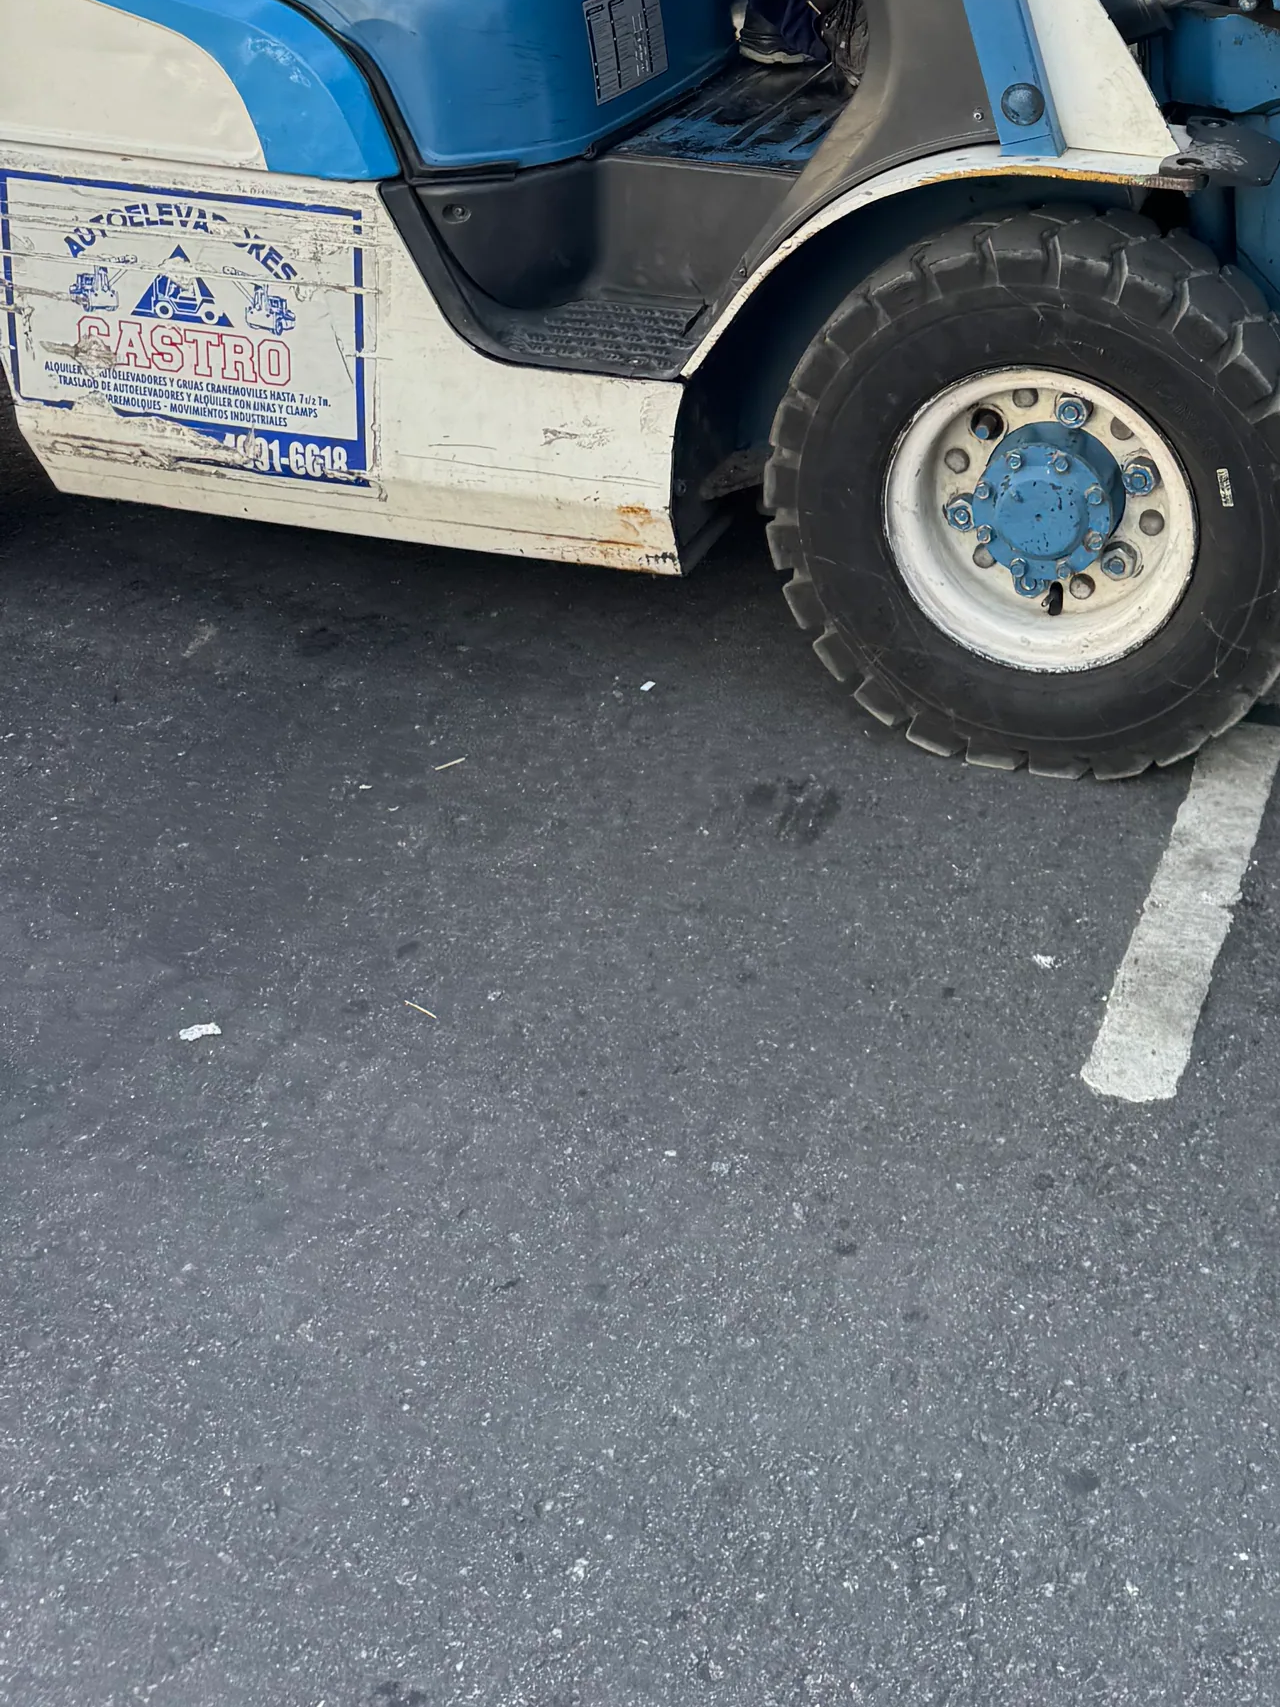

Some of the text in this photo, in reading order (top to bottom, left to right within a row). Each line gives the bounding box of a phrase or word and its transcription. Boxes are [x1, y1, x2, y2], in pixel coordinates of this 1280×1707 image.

[58, 374, 99, 389] TRASLADO
[101, 379, 112, 392] DE
[113, 382, 184, 401] AUTOELEVADORES
[186, 392, 192, 402] Y
[194, 394, 232, 409] ALQUILER
[234, 399, 251, 410] CON
[279, 404, 284, 414] Y
[286, 405, 318, 418] CLAMPS
[169, 377, 175, 388] Y
[176, 379, 204, 391] GRUAS
[206, 382, 267, 400] CRANEMOVILES
[270, 390, 296, 403] HASTA
[170, 405, 229, 420] MOVIMIENTOS
[231, 411, 288, 427] INDUSTRIALES
